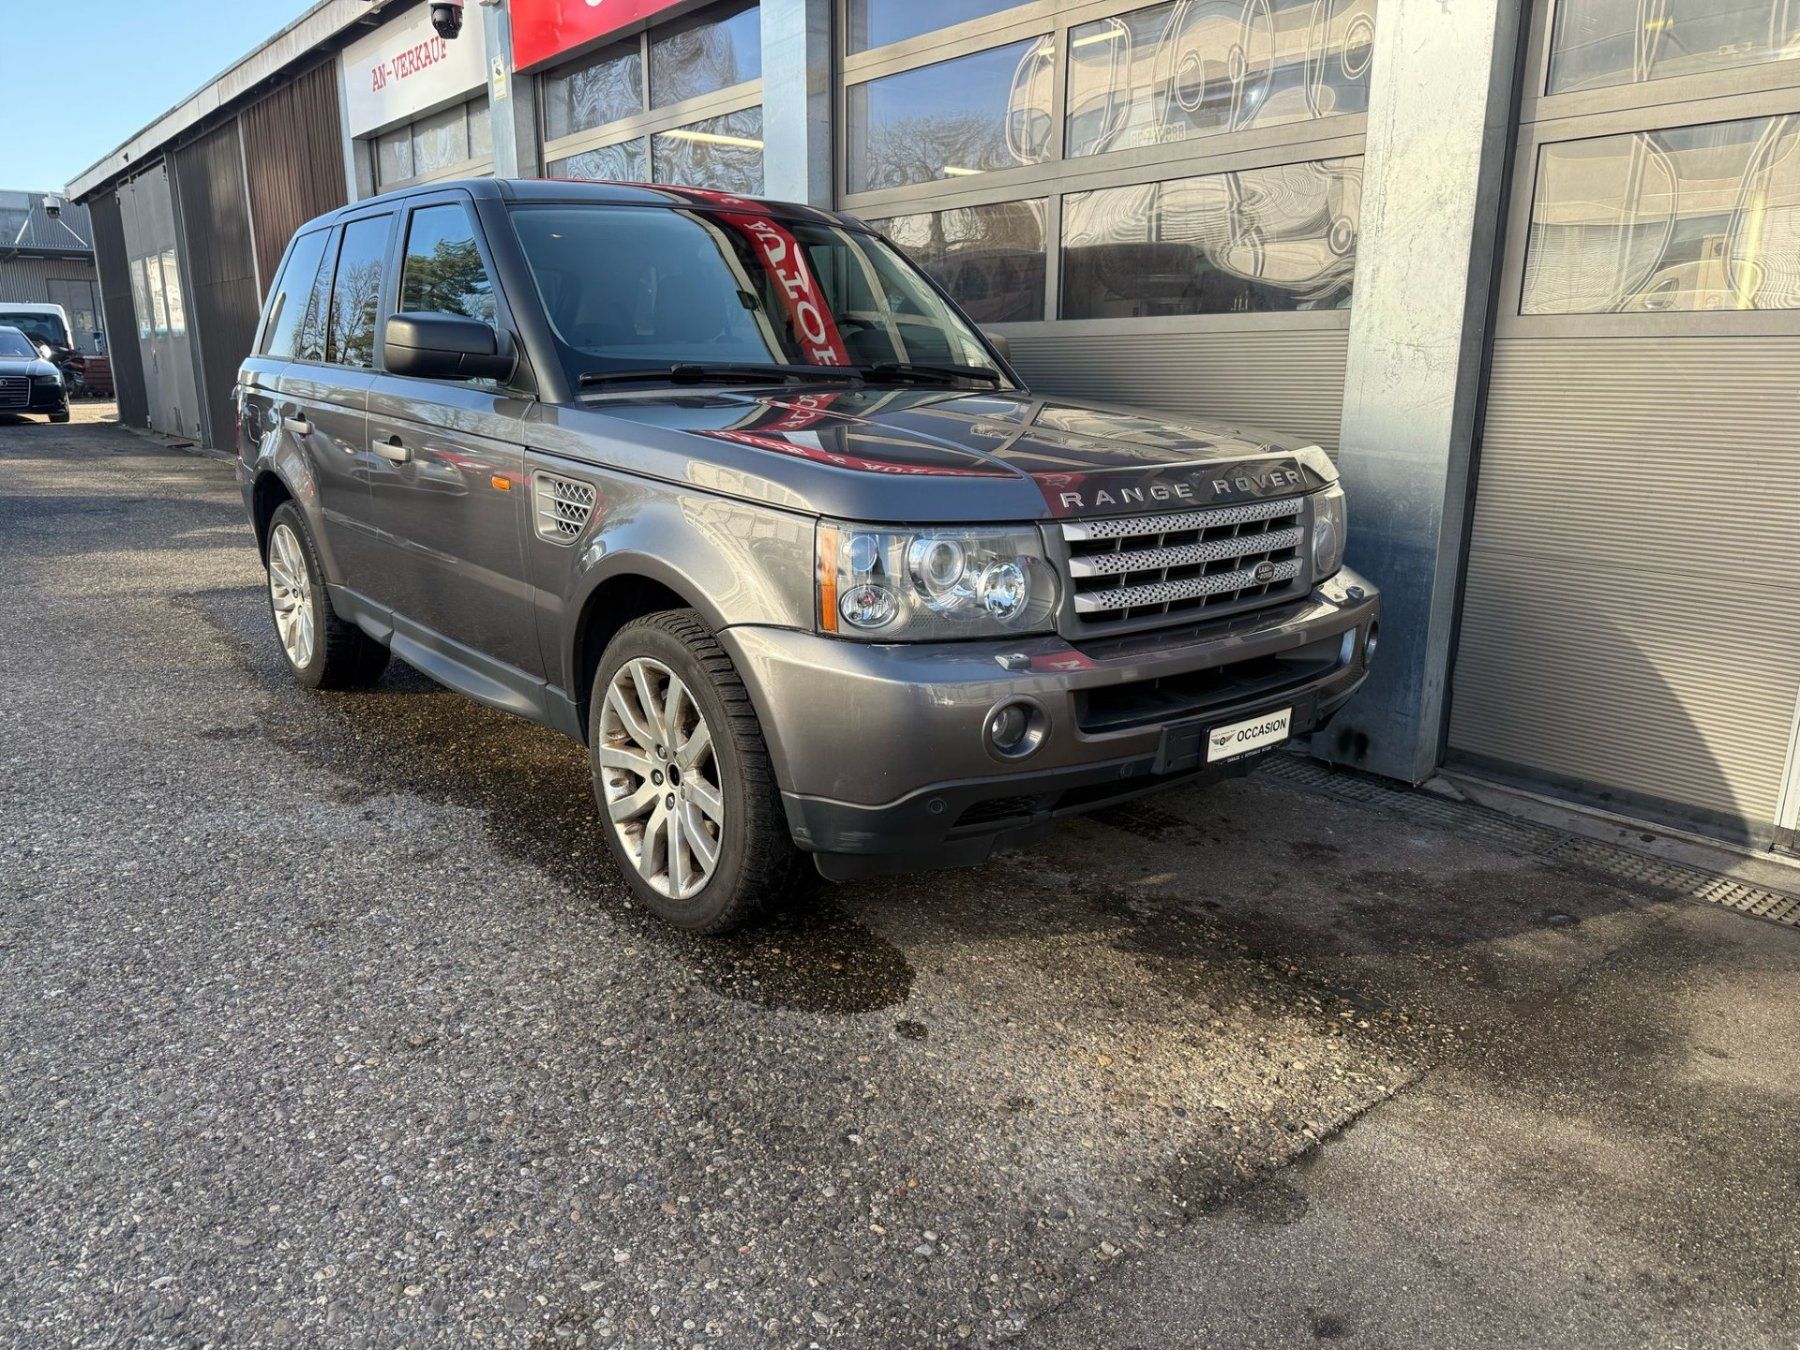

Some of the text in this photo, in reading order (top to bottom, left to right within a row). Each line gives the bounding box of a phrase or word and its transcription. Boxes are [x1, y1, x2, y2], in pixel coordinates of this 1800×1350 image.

[371, 36, 447, 92] AN-VERKAUF
[1060, 470, 1301, 508] RANGE ROVER
[1236, 717, 1288, 742] OCCASION
